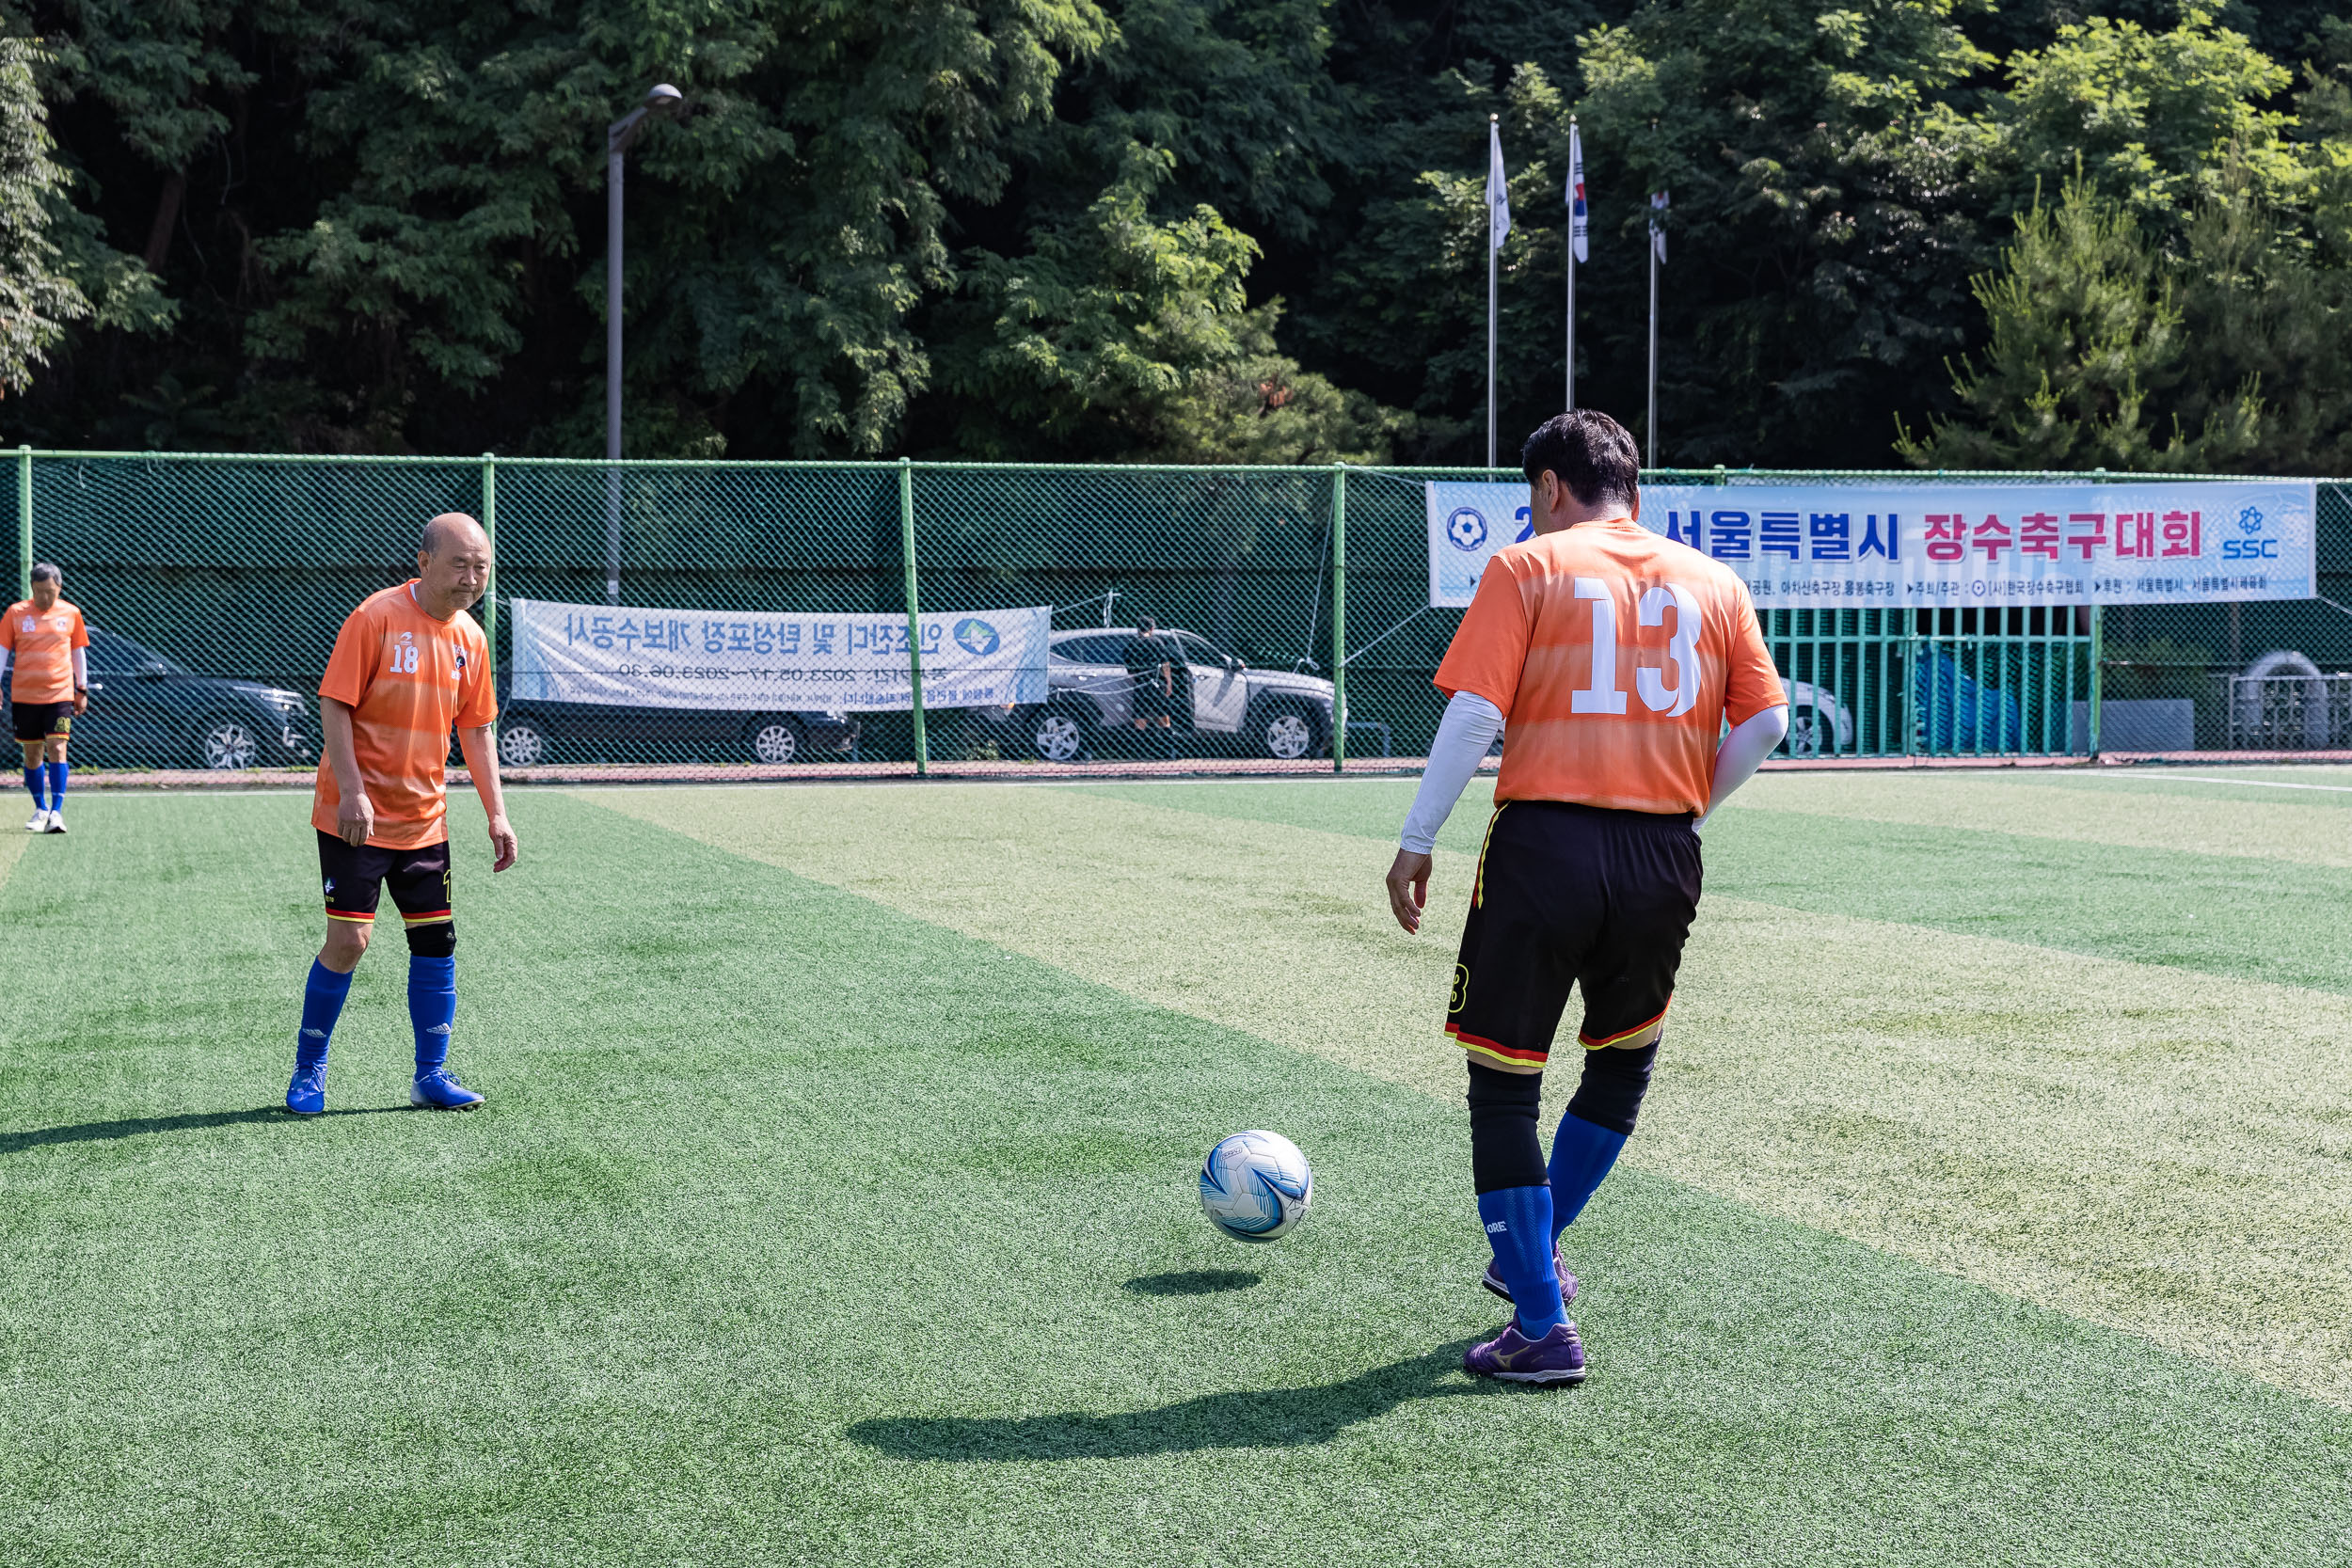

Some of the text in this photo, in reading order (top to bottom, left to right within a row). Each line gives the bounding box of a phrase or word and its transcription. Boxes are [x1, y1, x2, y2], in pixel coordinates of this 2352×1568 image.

[1665, 510, 1899, 561] 서울특별시
[1924, 510, 2201, 562] 장수축구대회
[2223, 538, 2278, 560] SSC
[389, 644, 419, 673] 18
[1571, 576, 1702, 718] 13
[1485, 1220, 1507, 1234] ORE
